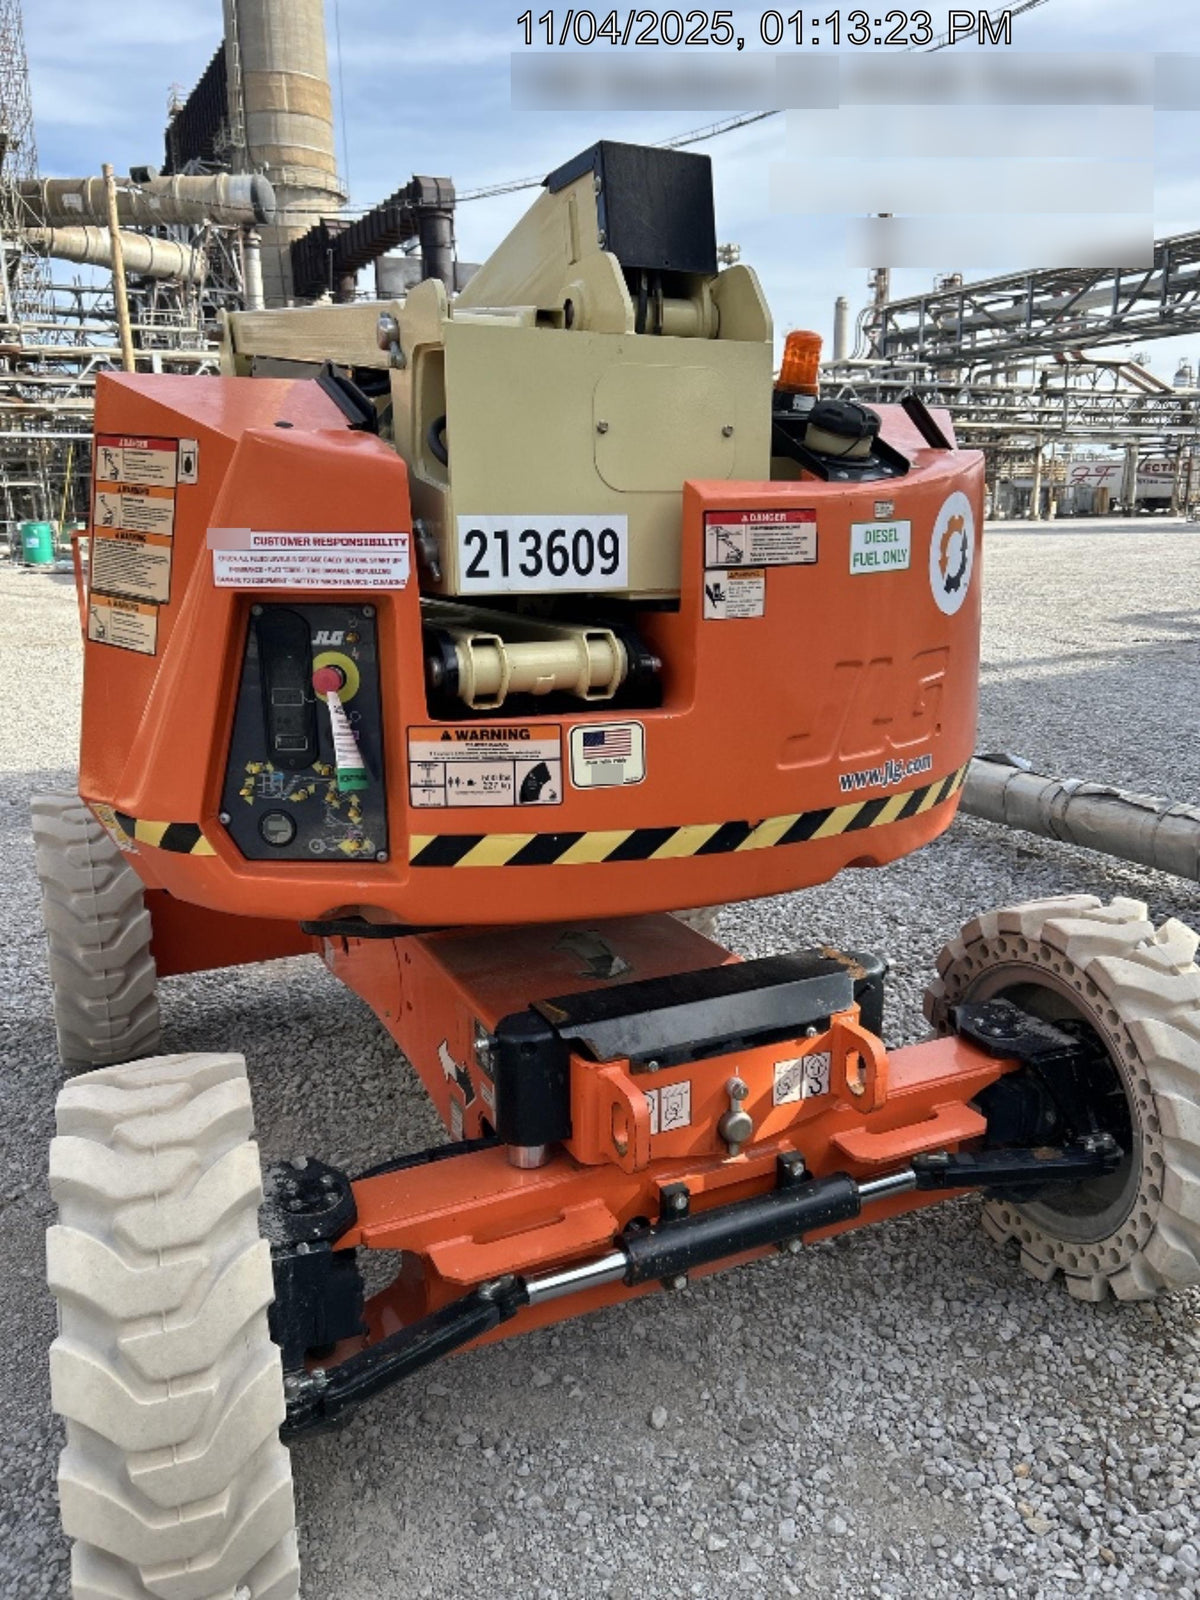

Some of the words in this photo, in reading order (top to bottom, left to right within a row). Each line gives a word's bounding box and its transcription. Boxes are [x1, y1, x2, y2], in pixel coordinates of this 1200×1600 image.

[749, 513, 787, 522] DANGER
[253, 536, 310, 547] CUSTOMER
[312, 537, 407, 547] RESPONSIBILITY
[864, 528, 899, 545] DIESEL
[463, 528, 620, 579] 213609
[853, 551, 881, 568] FUEL
[882, 548, 908, 565] ONLY
[312, 630, 345, 645] JLG
[455, 728, 531, 741] WARNING
[839, 753, 933, 792] www.jlg.com
